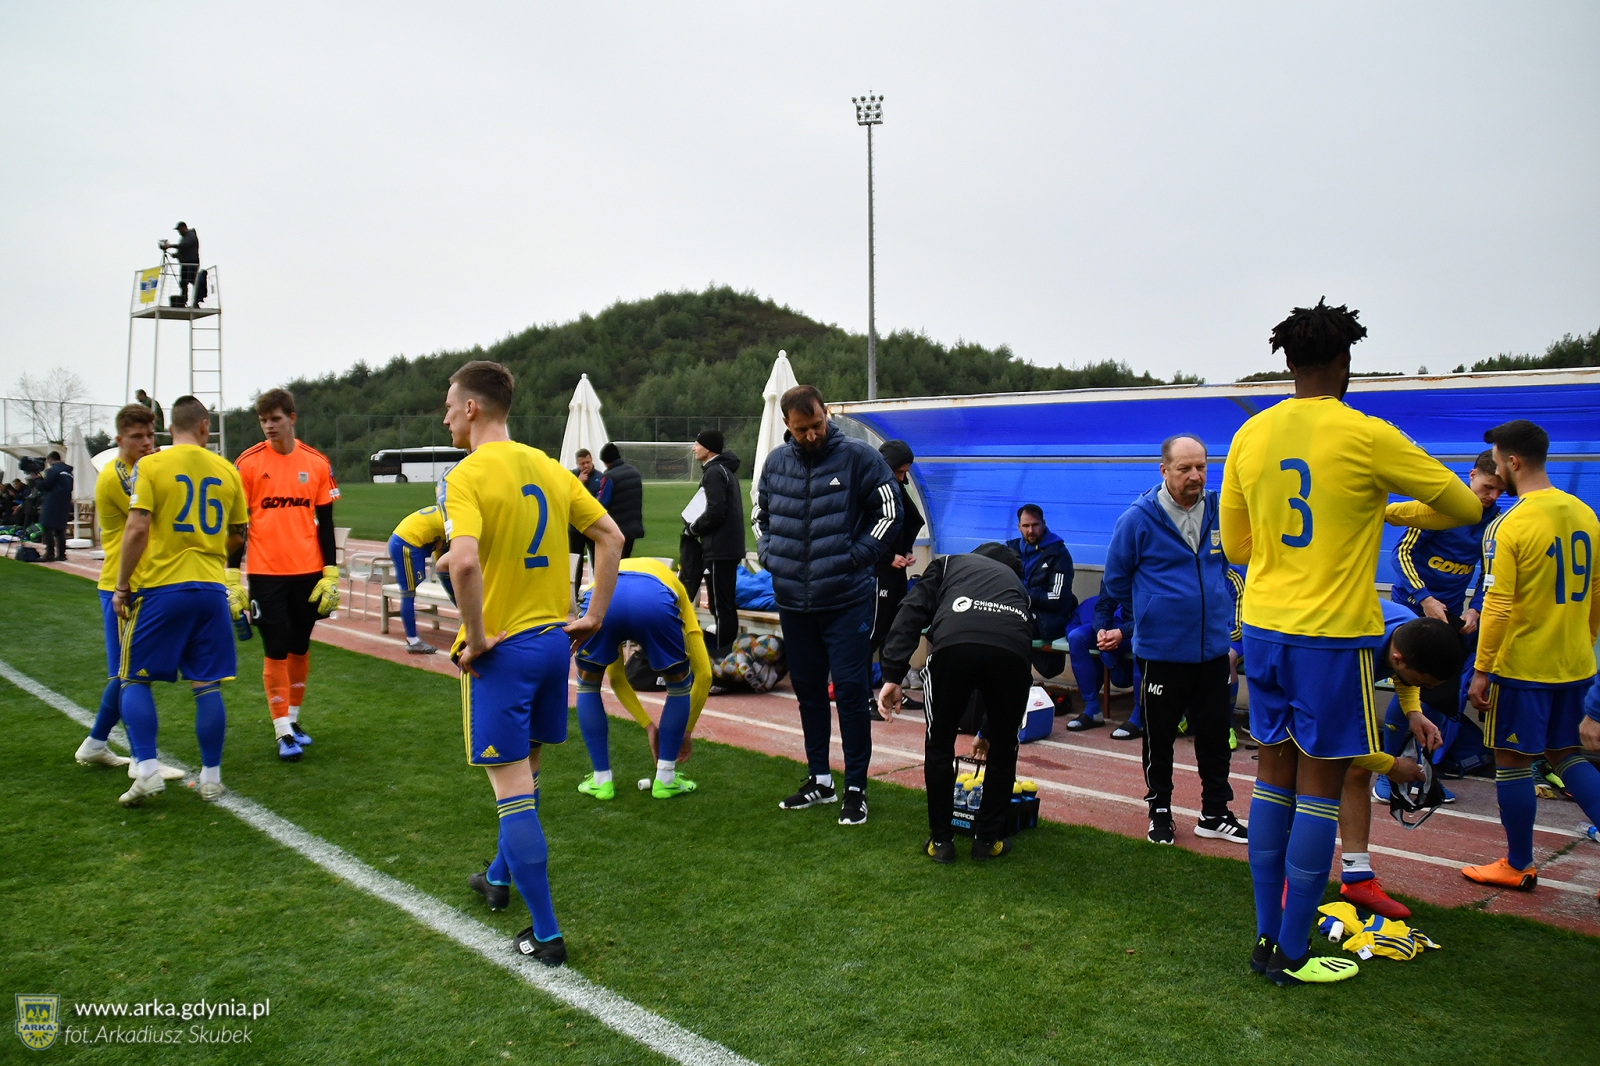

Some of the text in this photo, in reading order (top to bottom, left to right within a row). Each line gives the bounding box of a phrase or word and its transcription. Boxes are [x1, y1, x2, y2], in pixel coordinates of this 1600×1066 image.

[172, 474, 223, 535] 26
[261, 496, 310, 509] GDYNIA
[521, 484, 549, 569] 2
[1280, 458, 1313, 548] 3
[1546, 530, 1592, 605] 19
[1148, 682, 1163, 695] MG
